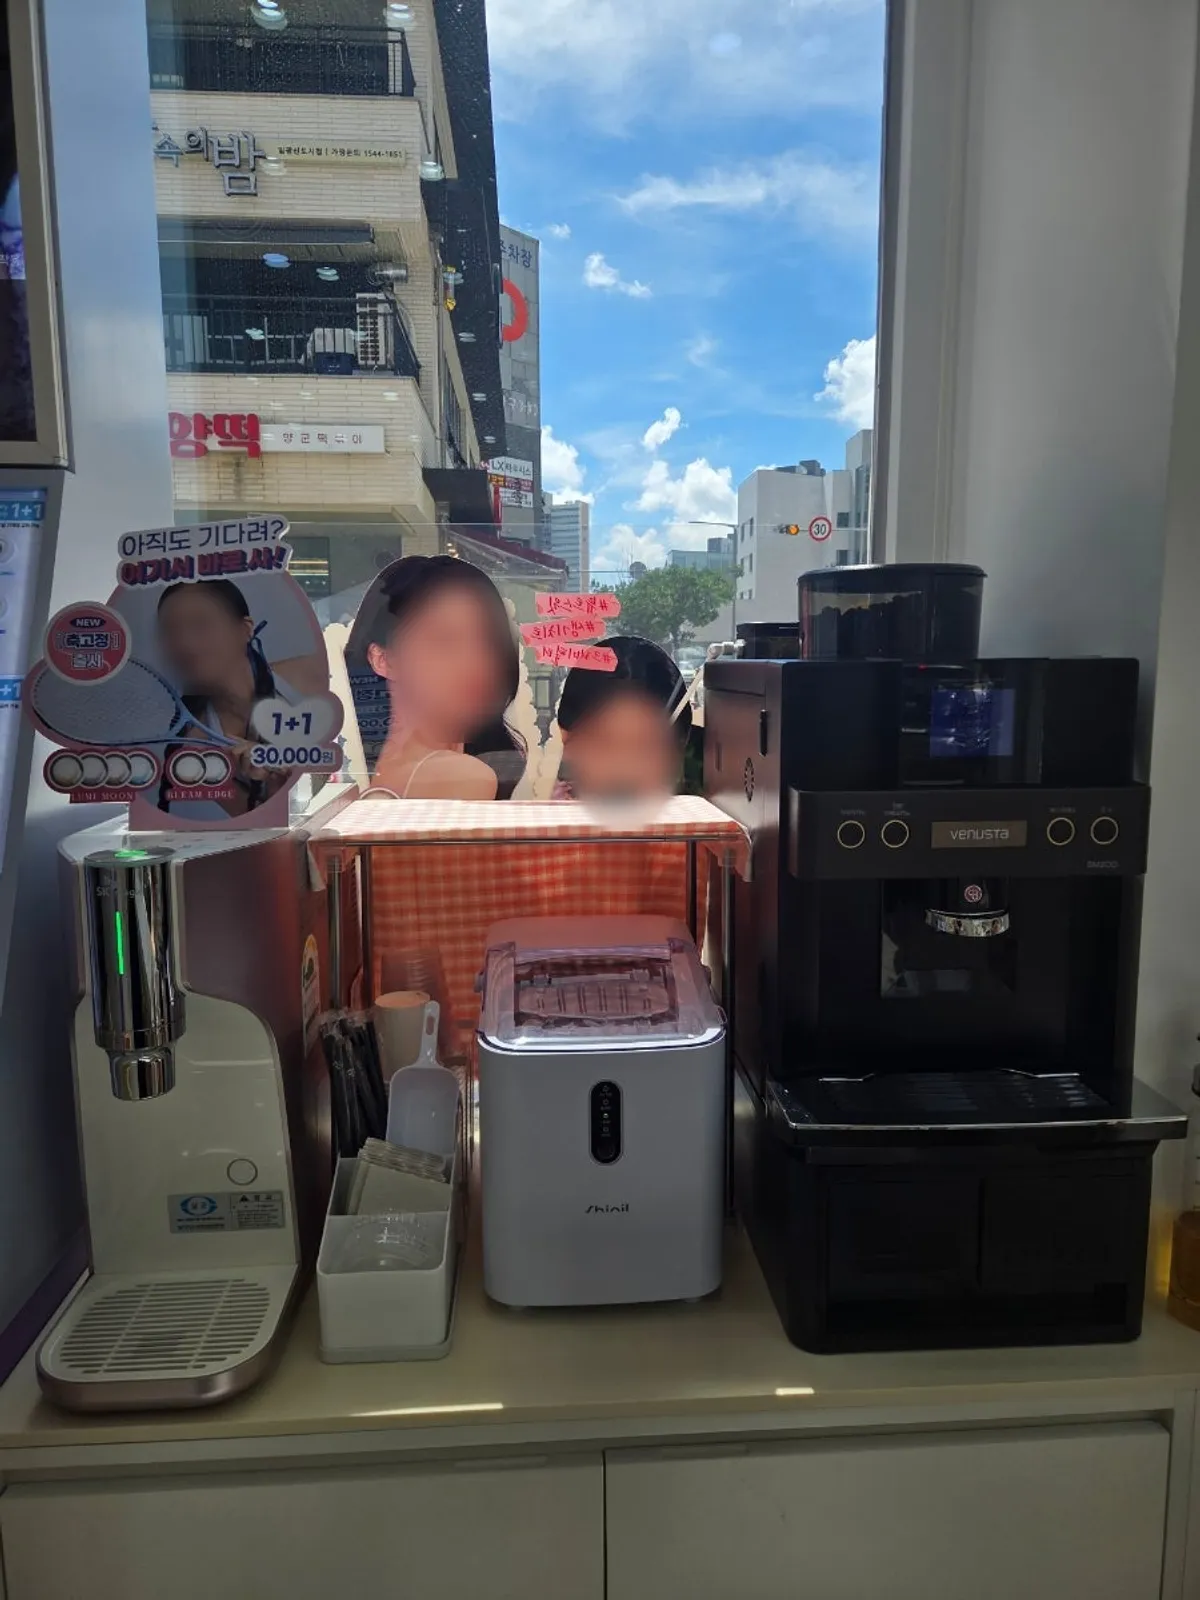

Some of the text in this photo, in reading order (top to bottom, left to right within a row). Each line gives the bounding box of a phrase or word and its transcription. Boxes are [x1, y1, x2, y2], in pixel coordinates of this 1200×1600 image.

[152, 123, 267, 196] 속의밤
[11, 503, 41, 519] 1+1
[122, 519, 284, 556] 아직도 기다려?
[813, 523, 827, 536] 30
[197, 550, 248, 576] 바로
[76, 618, 100, 627] NEW
[271, 712, 313, 735] 1+1
[252, 746, 335, 766] 30,000원
